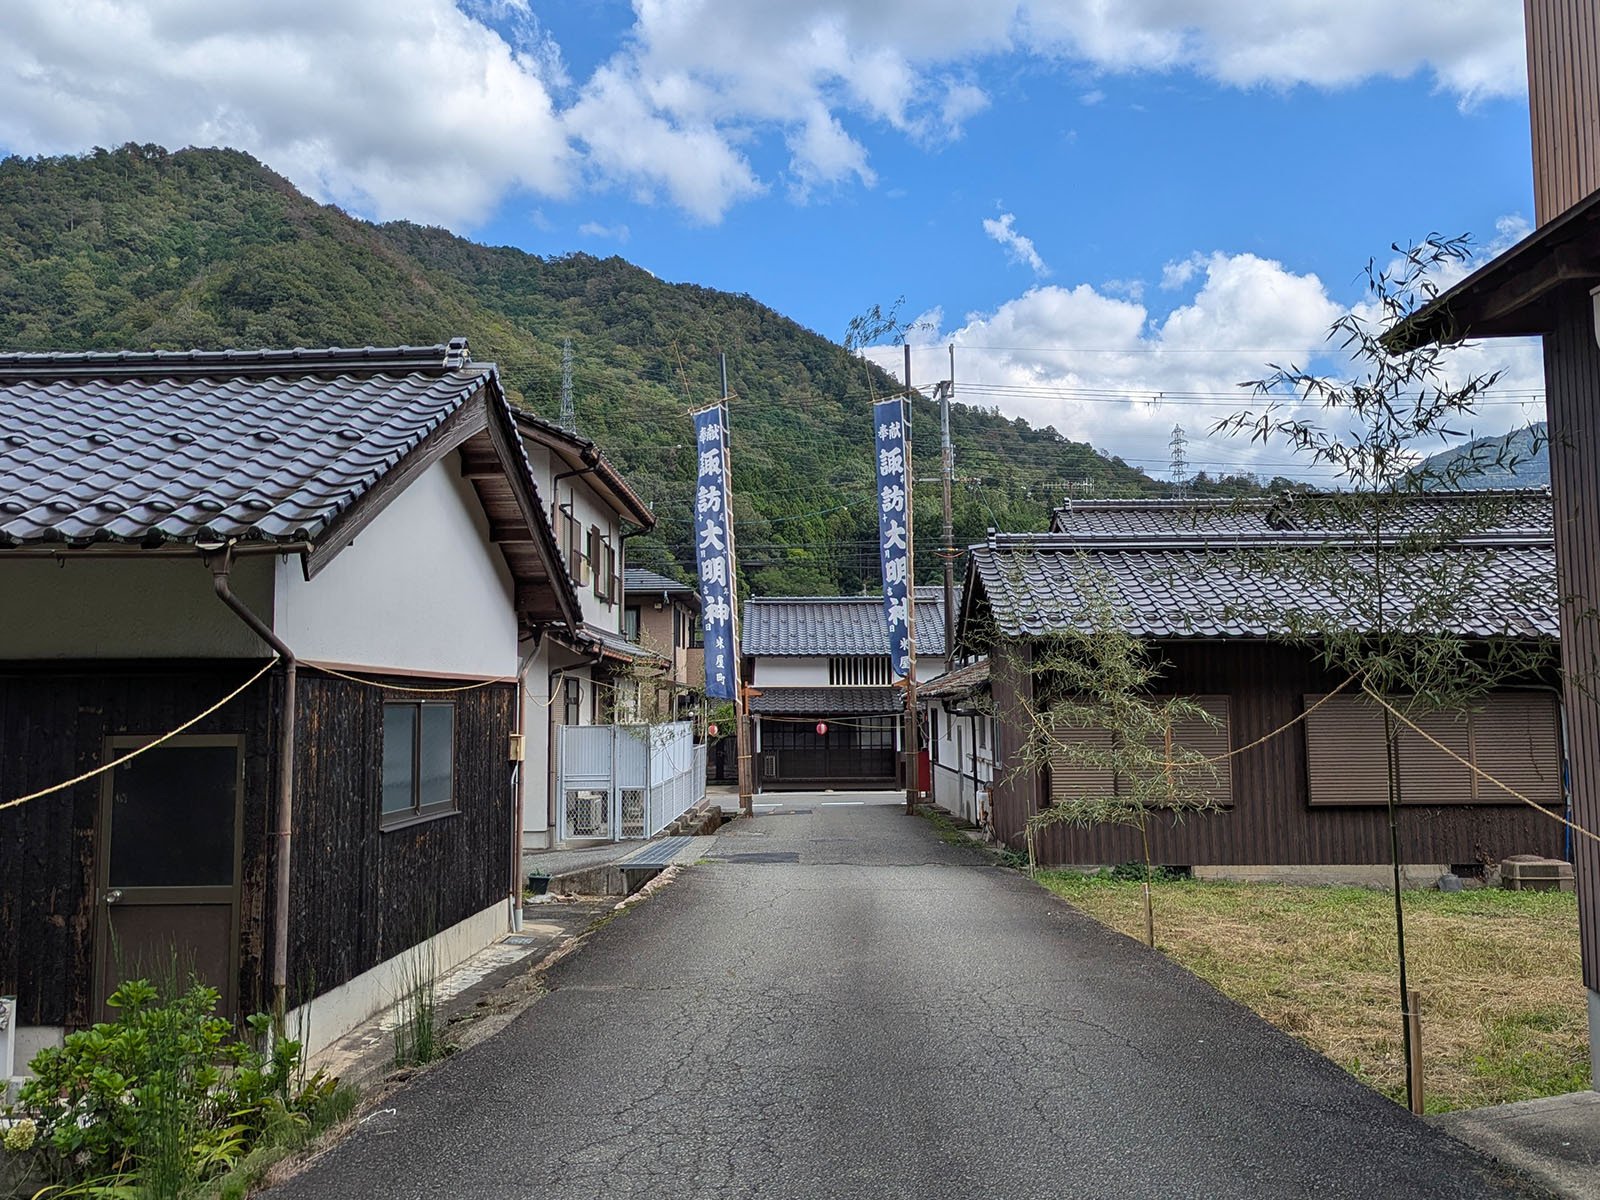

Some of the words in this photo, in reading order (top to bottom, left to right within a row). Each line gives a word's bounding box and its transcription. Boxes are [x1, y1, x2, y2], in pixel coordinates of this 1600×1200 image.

[878, 421, 902, 441] 奉献
[697, 447, 730, 628] 諏訪大明神
[879, 446, 908, 628] 諏訪大明神
[715, 635, 727, 686] 米屋町
[899, 637, 910, 674] 米屋
